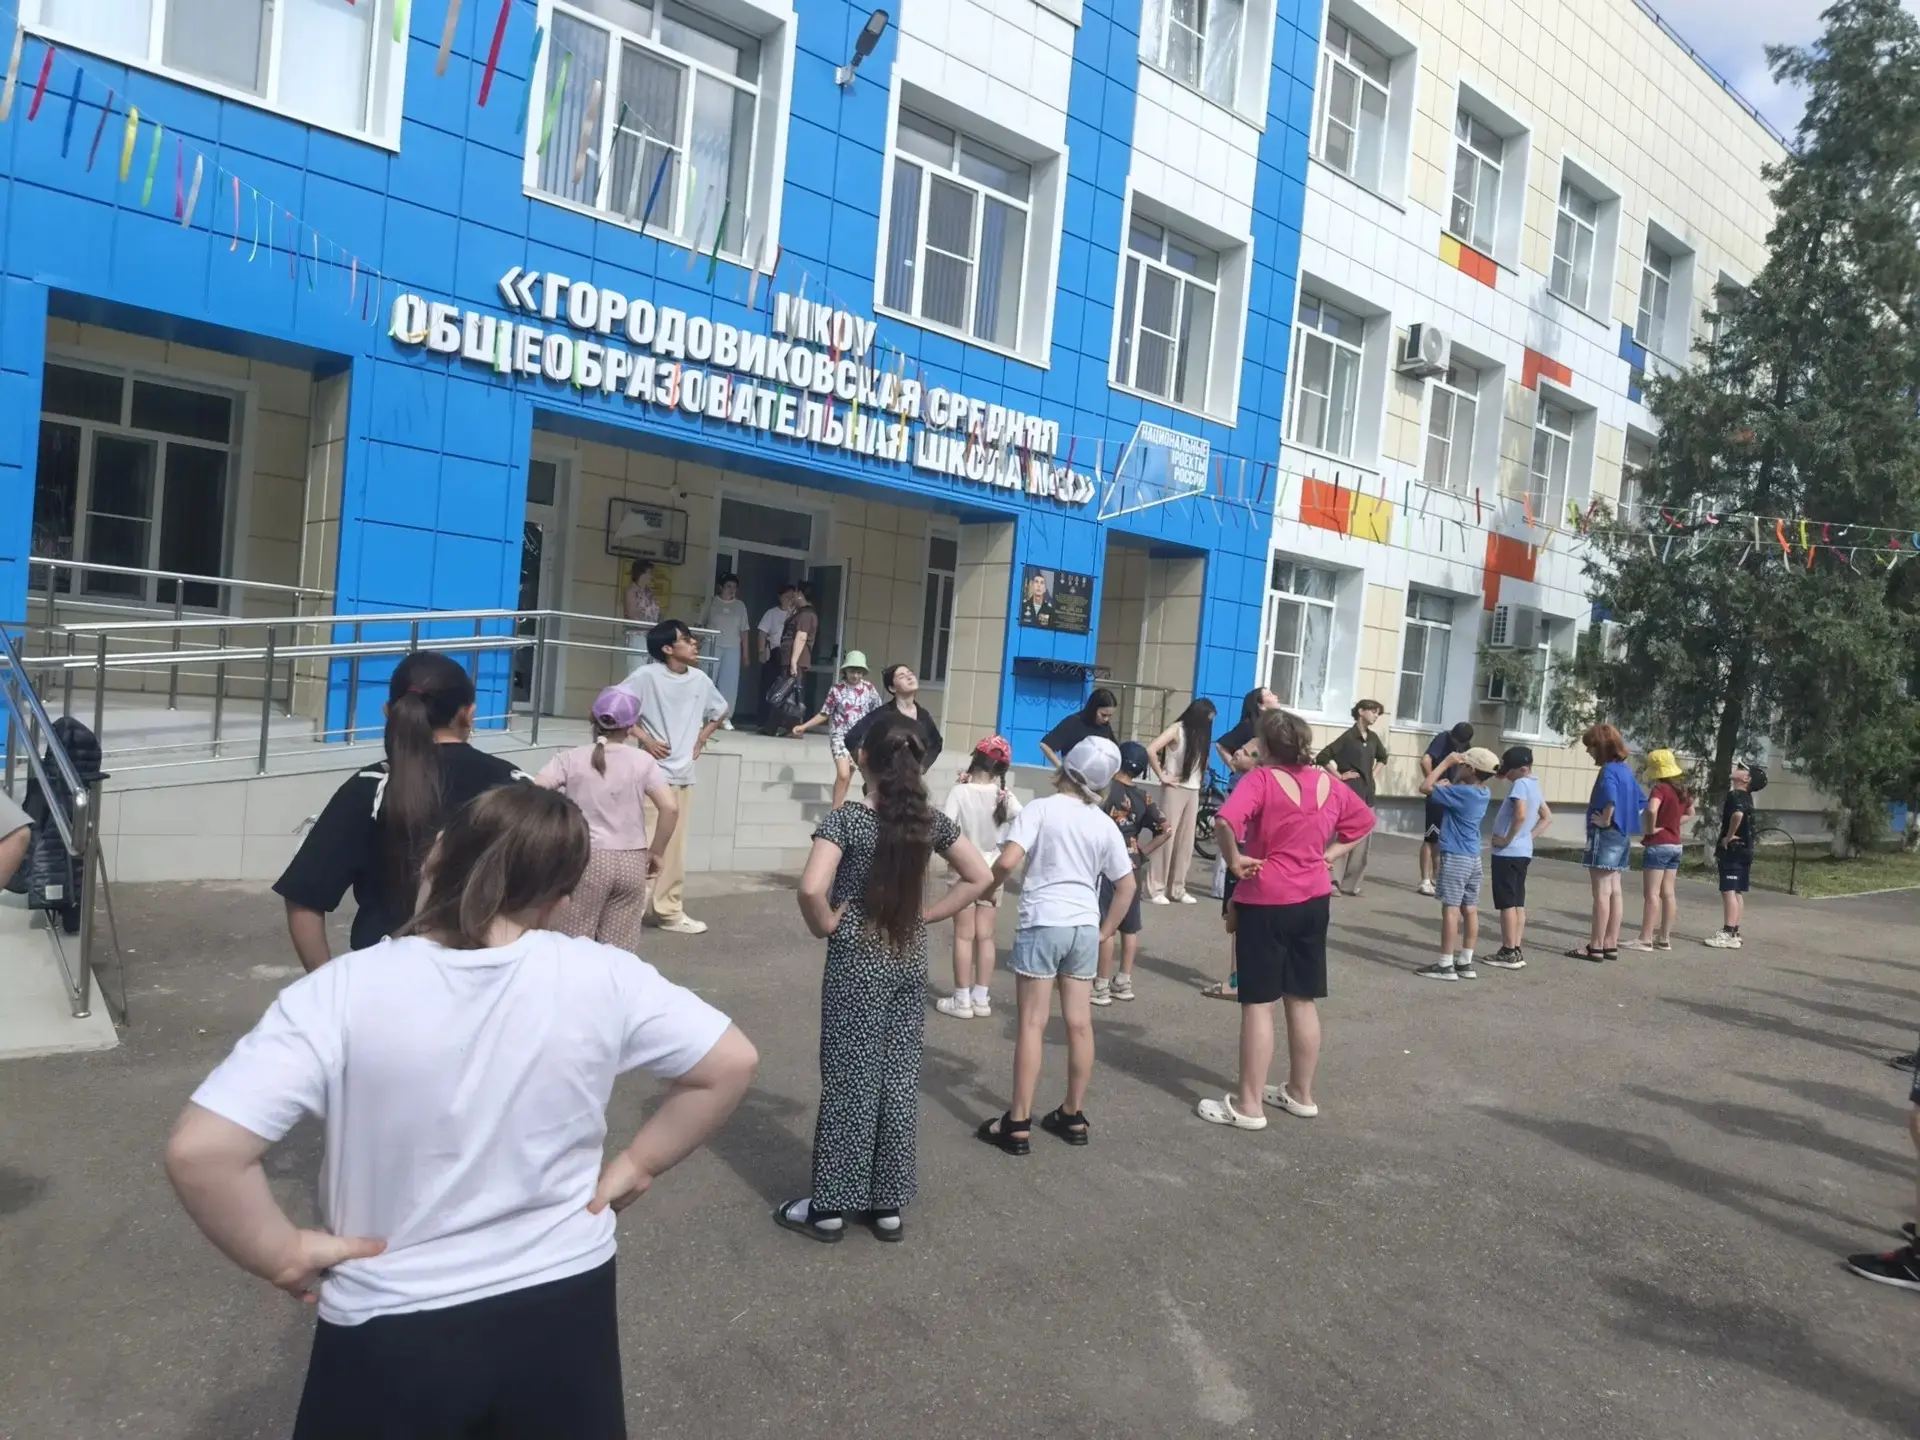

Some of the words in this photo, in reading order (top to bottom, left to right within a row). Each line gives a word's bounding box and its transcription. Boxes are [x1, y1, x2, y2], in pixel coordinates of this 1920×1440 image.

[498, 265, 921, 418] «ГОРОДОВИКОВСКАЯ
[773, 292, 877, 357] МКОУ
[390, 293, 909, 463] ОБЩЕОБРАЗОВАТЕЛЬНАЯ
[914, 431, 1022, 491] ШКОЛА
[1140, 425, 1208, 457] НАЦИОНАЛЬНЫЕ
[1174, 466, 1206, 488] РОССИИ
